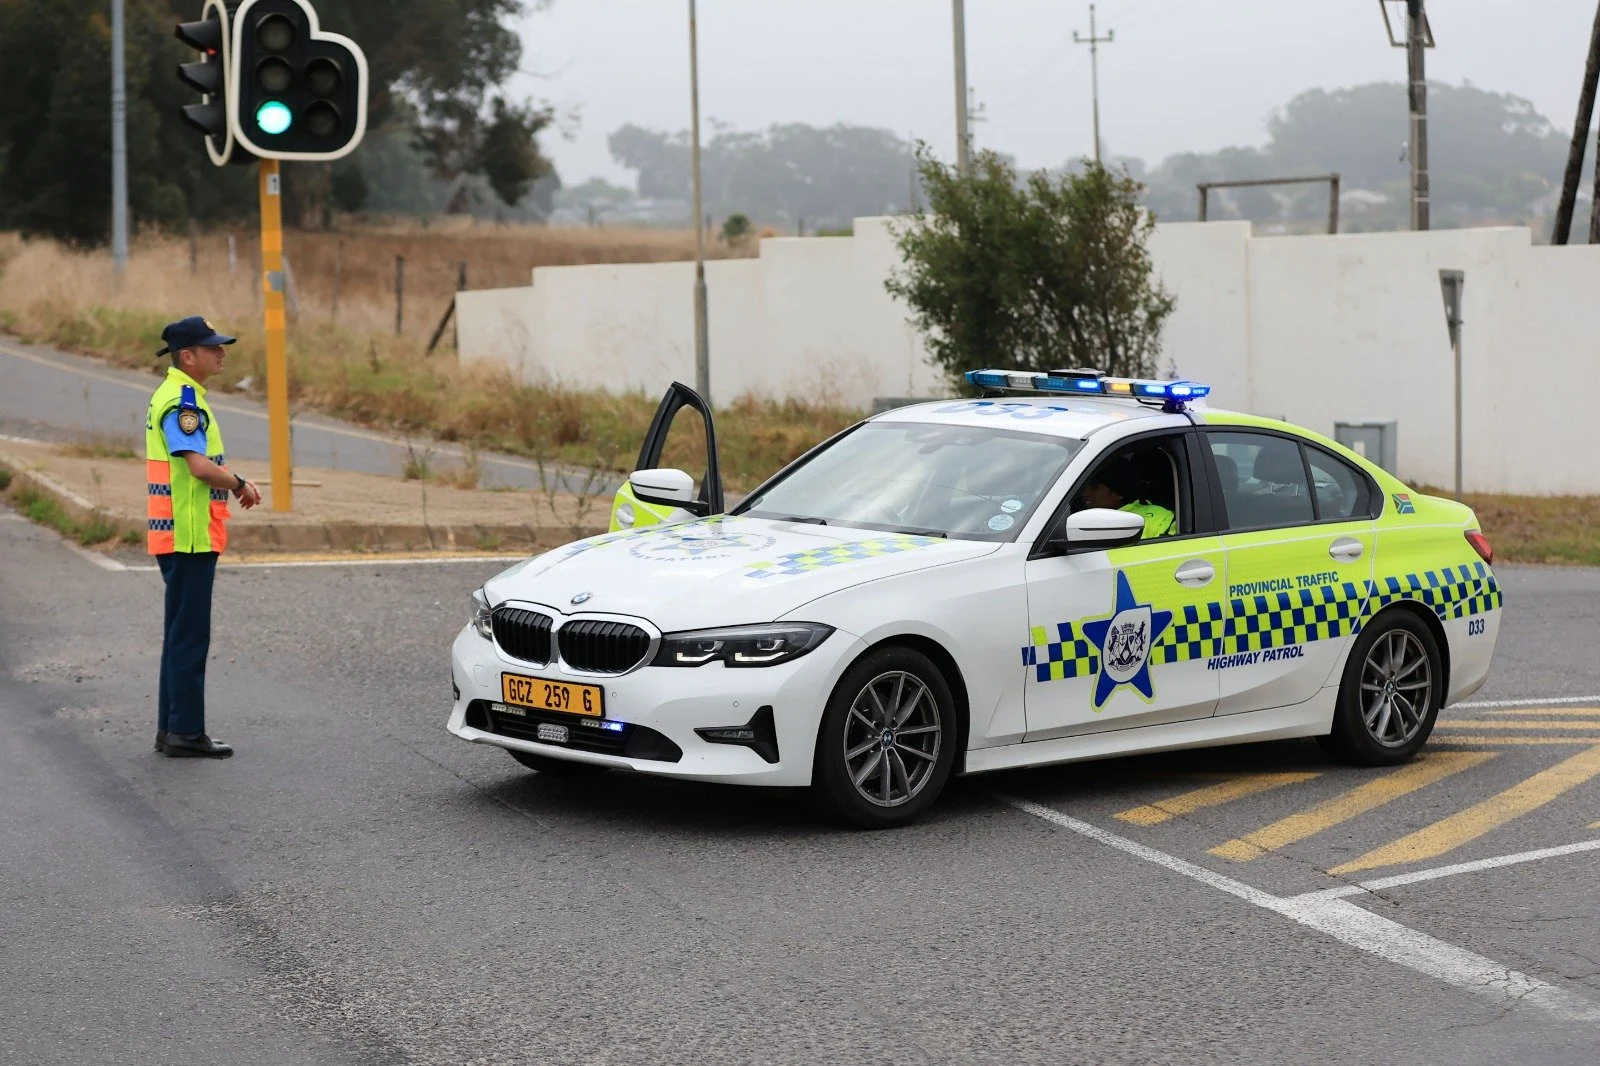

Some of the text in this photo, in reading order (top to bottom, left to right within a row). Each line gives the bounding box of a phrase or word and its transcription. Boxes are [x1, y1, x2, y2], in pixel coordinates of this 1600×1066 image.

[1229, 571, 1339, 598] PROVINCIAL TRAFFIC
[1468, 618, 1485, 637] D33
[1207, 645, 1304, 670] HIGHWAY PATROL
[509, 678, 592, 712] GCZ 259 G
